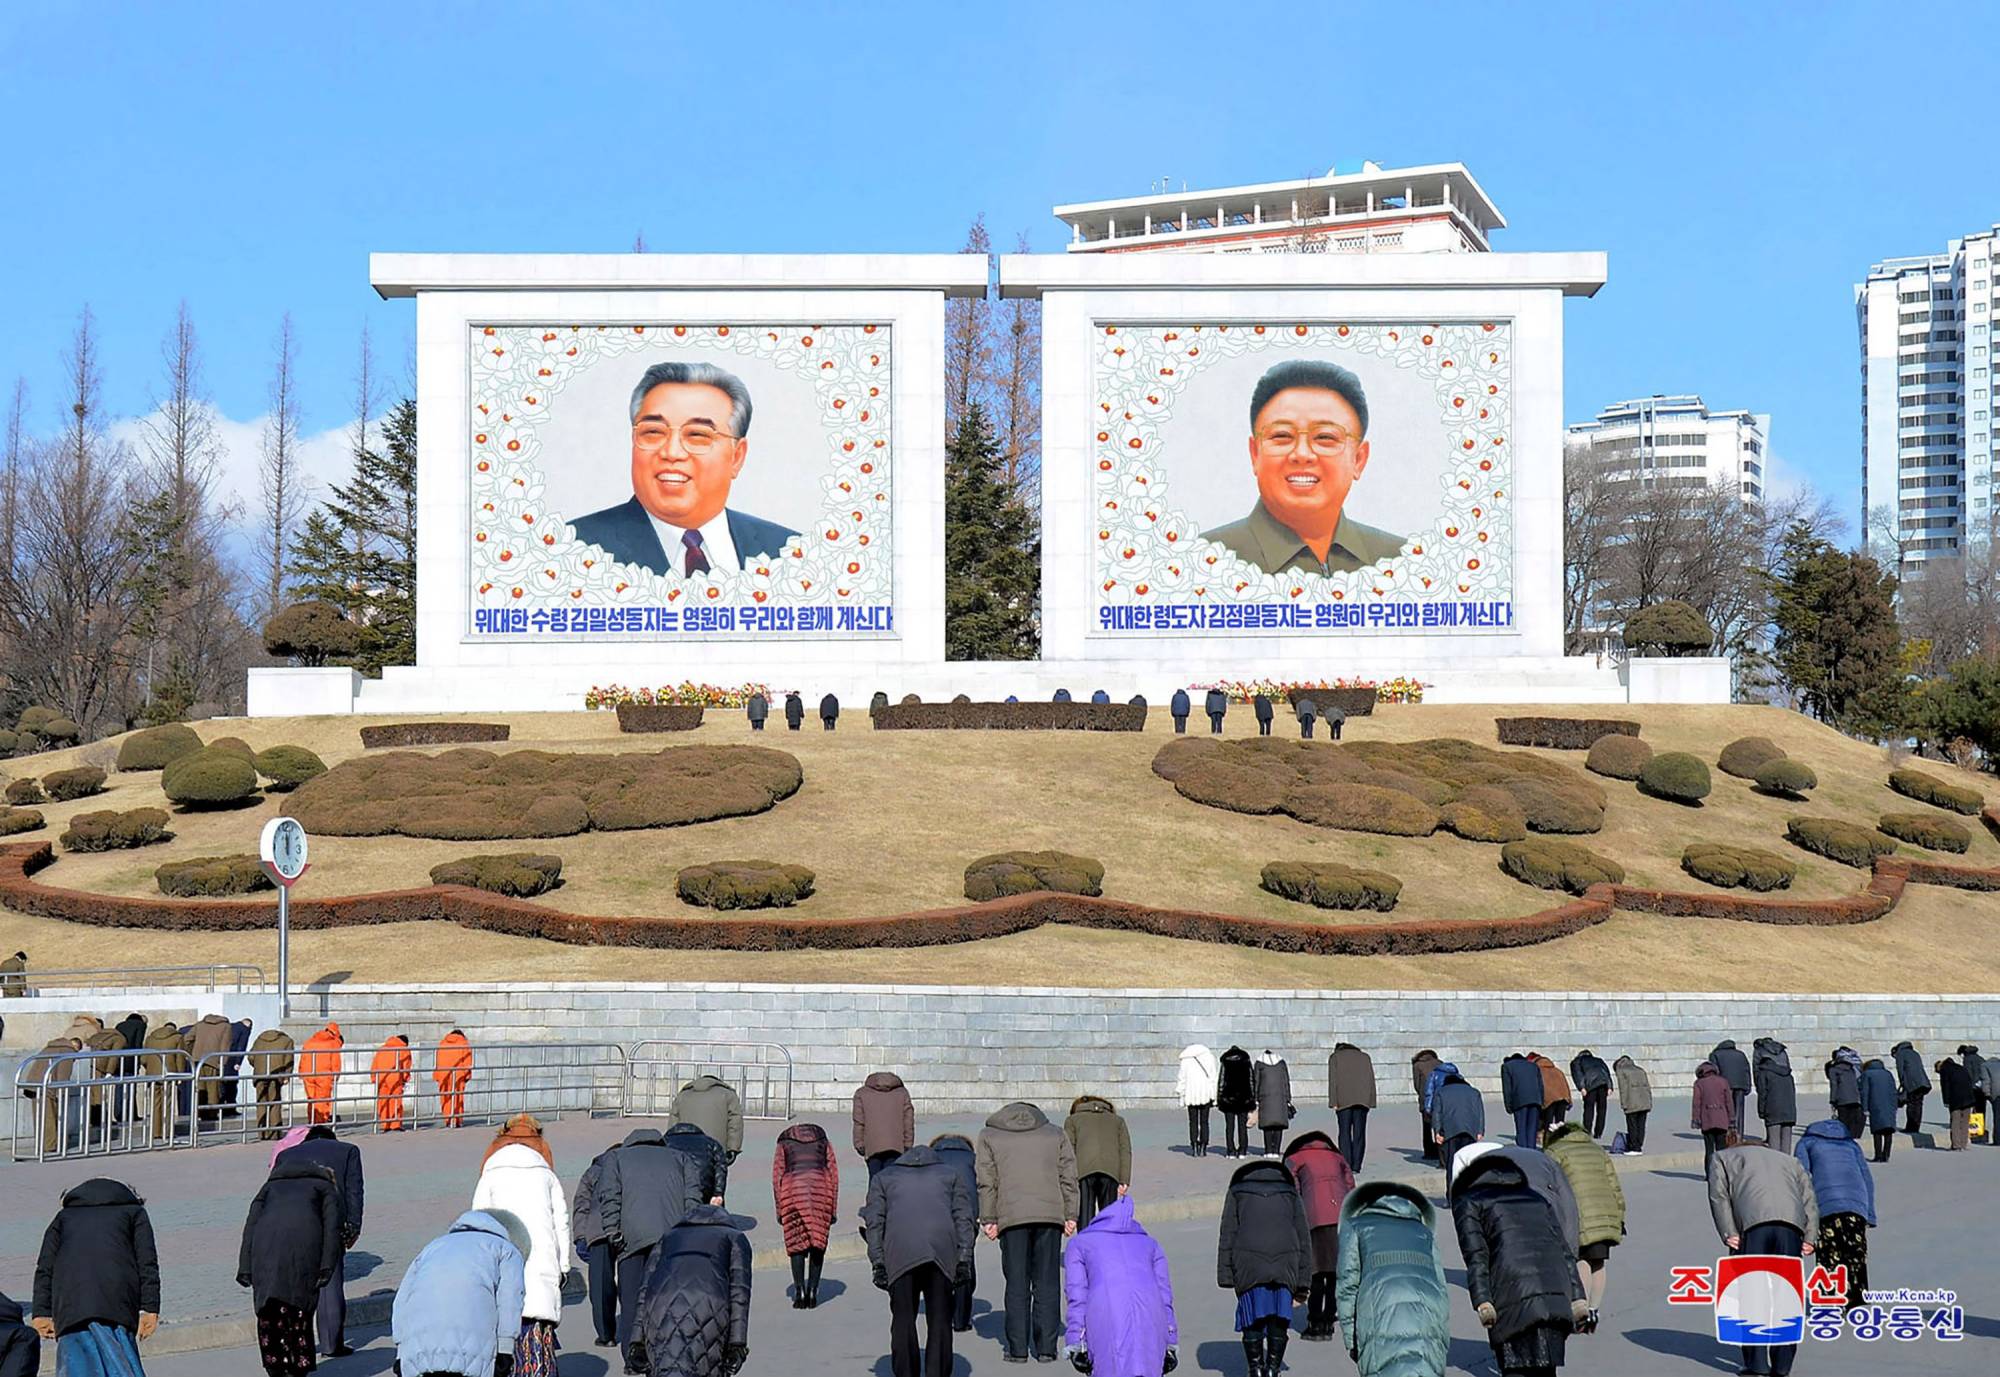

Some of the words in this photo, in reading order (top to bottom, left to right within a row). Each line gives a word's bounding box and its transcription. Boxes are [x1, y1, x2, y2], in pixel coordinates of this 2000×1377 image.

[475, 608, 528, 633] 위대한
[531, 607, 569, 632] 수령
[571, 607, 679, 632] 김일성동지는
[682, 606, 736, 631] 영원히
[739, 606, 795, 631] 우리와
[797, 606, 834, 631] 함께
[837, 606, 893, 631] 계신다
[1099, 605, 1152, 630] 위대한
[1154, 604, 1207, 629] 령도자
[1208, 603, 1313, 629] 김정일동지는
[1315, 603, 1366, 628] 영원히
[1367, 602, 1420, 627] 우리와
[1422, 602, 1458, 627] 함께
[1459, 601, 1513, 627] 계신다
[295, 844, 302, 855] 3
[282, 865, 289, 875] 6
